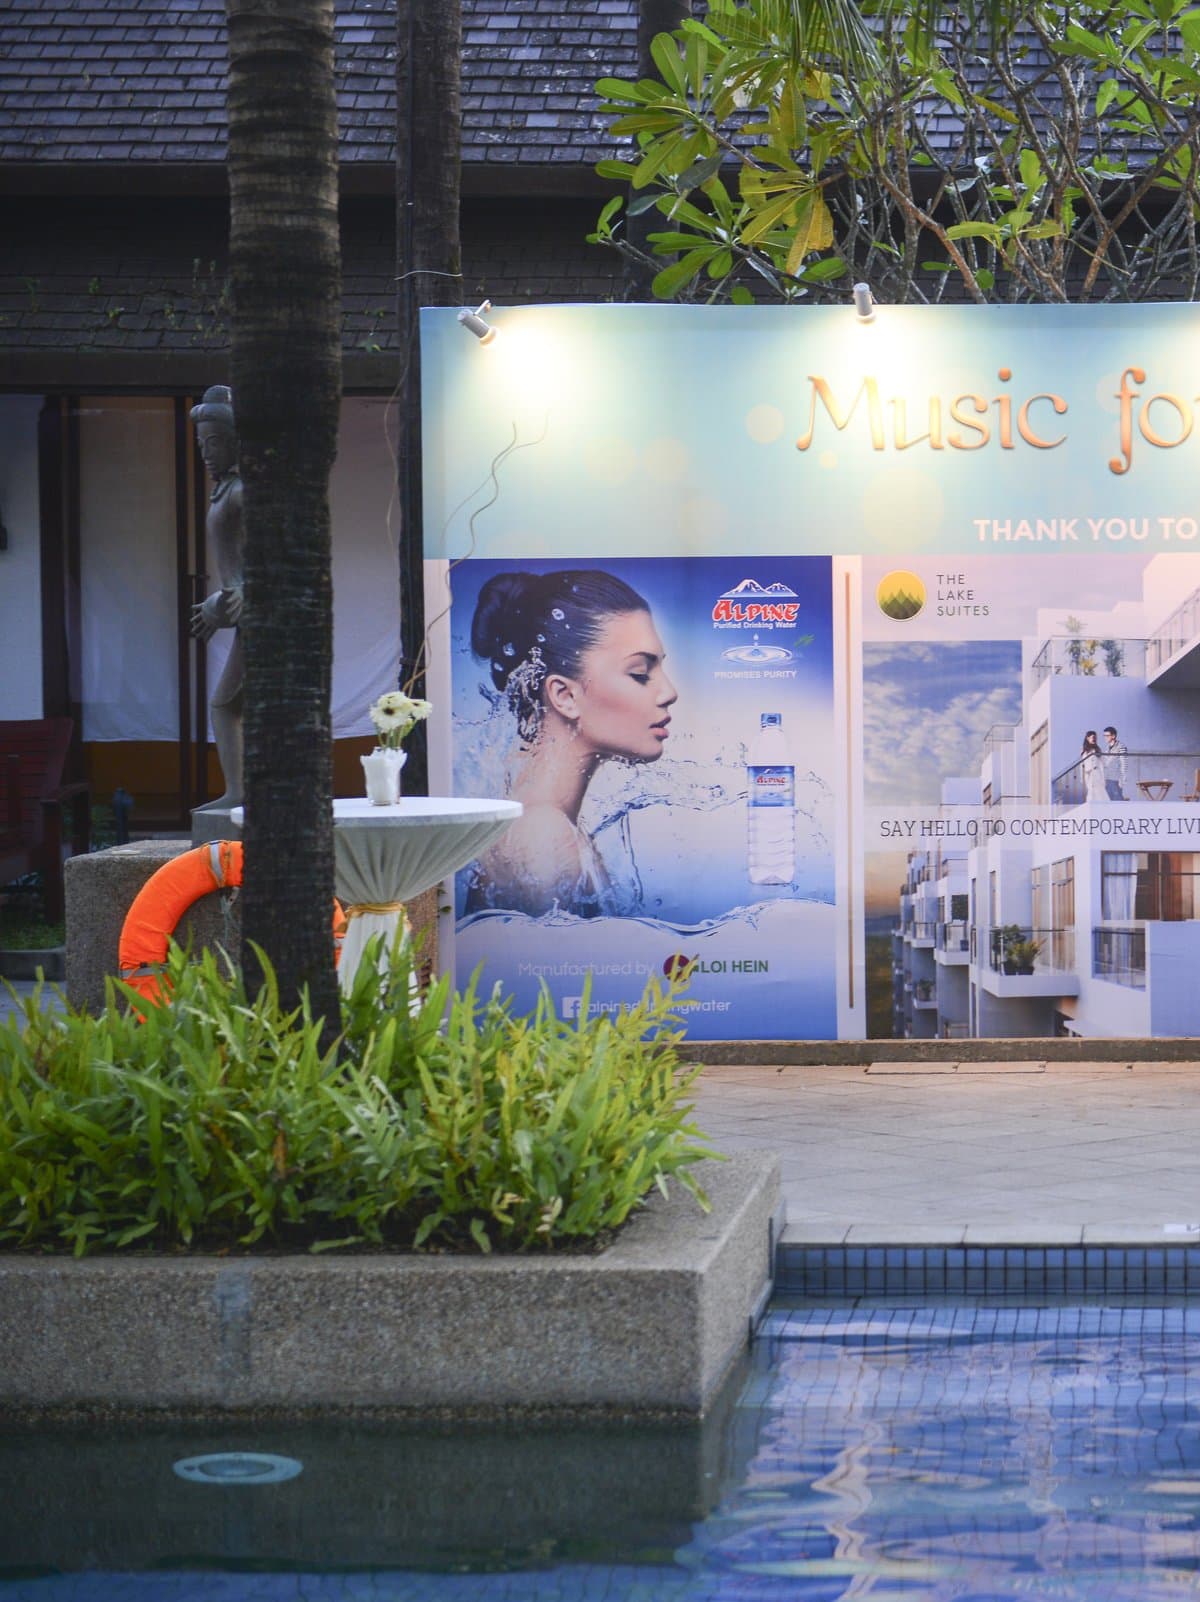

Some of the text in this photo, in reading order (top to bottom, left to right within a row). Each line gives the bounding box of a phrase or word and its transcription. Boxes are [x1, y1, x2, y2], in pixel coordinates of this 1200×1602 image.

[796, 367, 1068, 450] Music
[973, 518, 1079, 541] THANK
[1087, 518, 1149, 541] YOU
[1157, 517, 1199, 540] TO
[936, 574, 965, 585] THE
[937, 589, 975, 601] LAKE
[937, 605, 990, 617] SUITES
[743, 622, 773, 630] Drinking
[775, 621, 797, 629] Water
[763, 670, 797, 679] PURITY
[880, 820, 916, 837] SAY
[920, 819, 978, 837] HELLO
[983, 819, 1006, 836] TO
[1010, 818, 1162, 836] CONTEMPORARY
[518, 959, 769, 978] Manufactured by LOI HEIN
